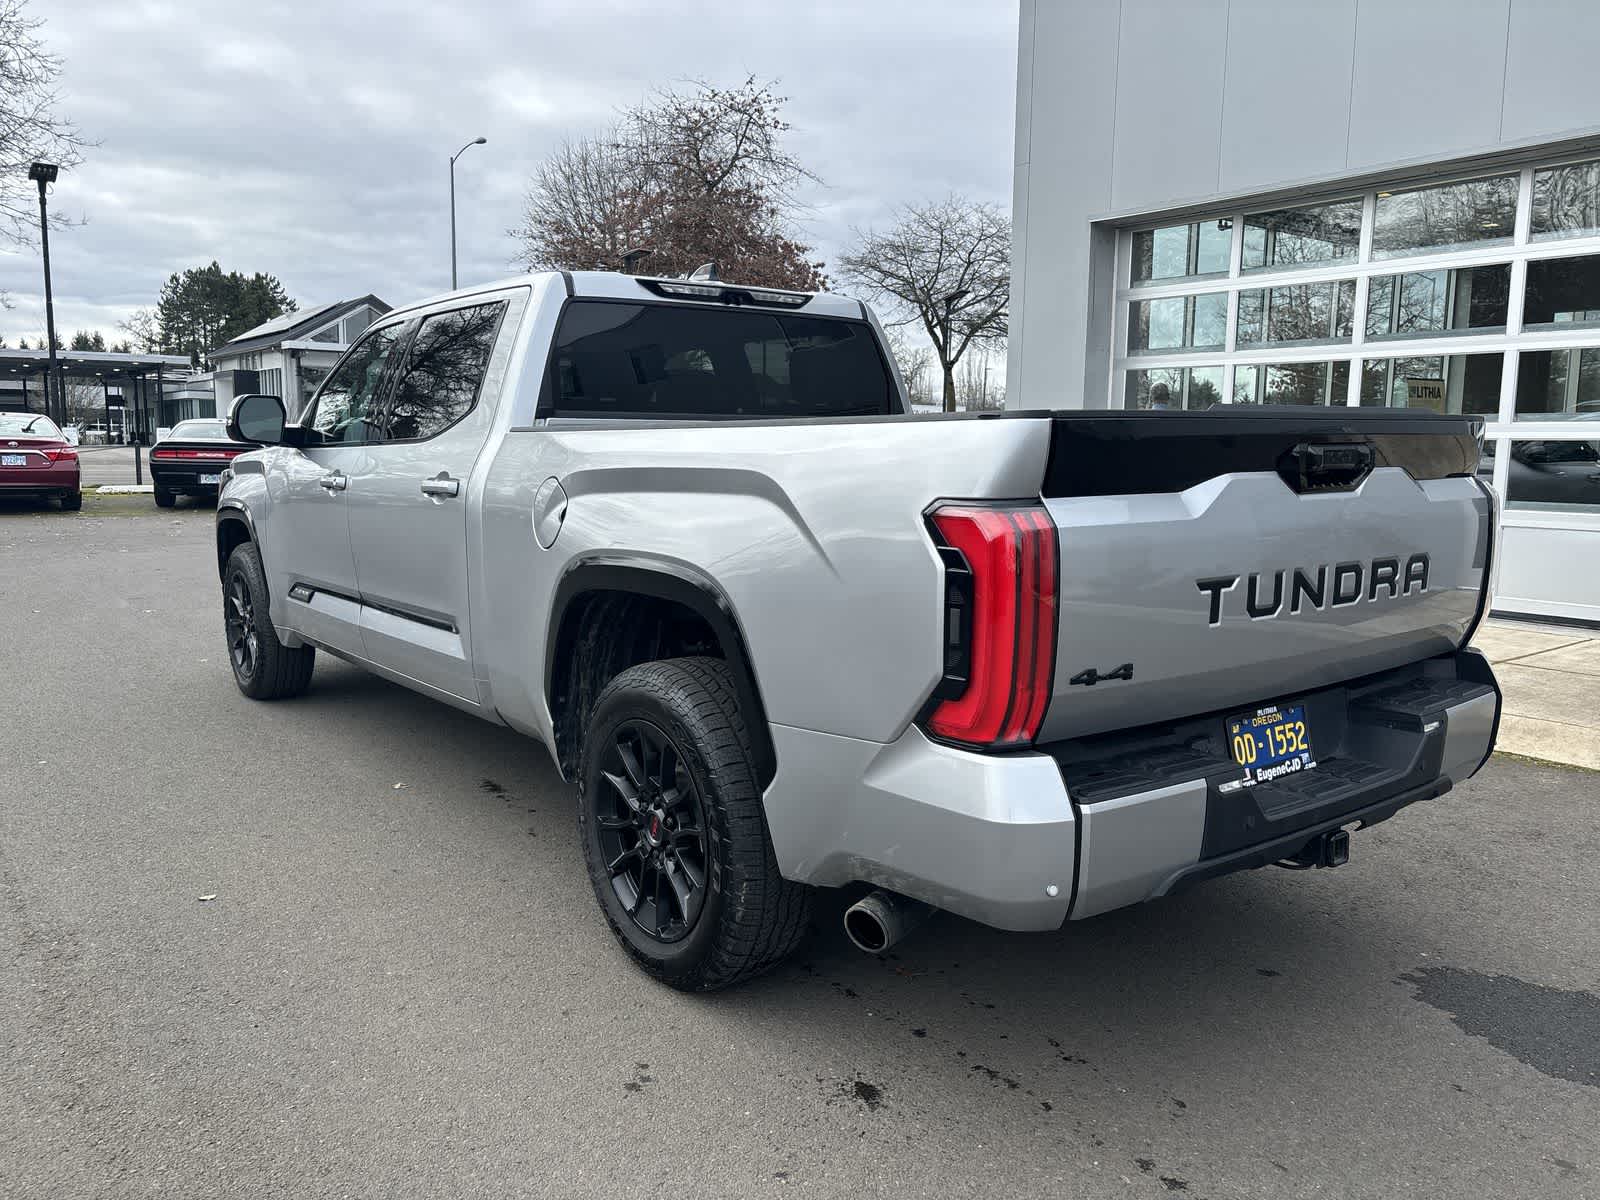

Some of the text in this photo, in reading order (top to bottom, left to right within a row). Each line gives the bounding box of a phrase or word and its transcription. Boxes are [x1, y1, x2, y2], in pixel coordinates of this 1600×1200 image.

[1416, 386, 1441, 398] LITHIA
[1195, 551, 1431, 628] TUNDRA
[1252, 713, 1282, 727] OREGON
[1256, 758, 1301, 781] EugeneCJD
